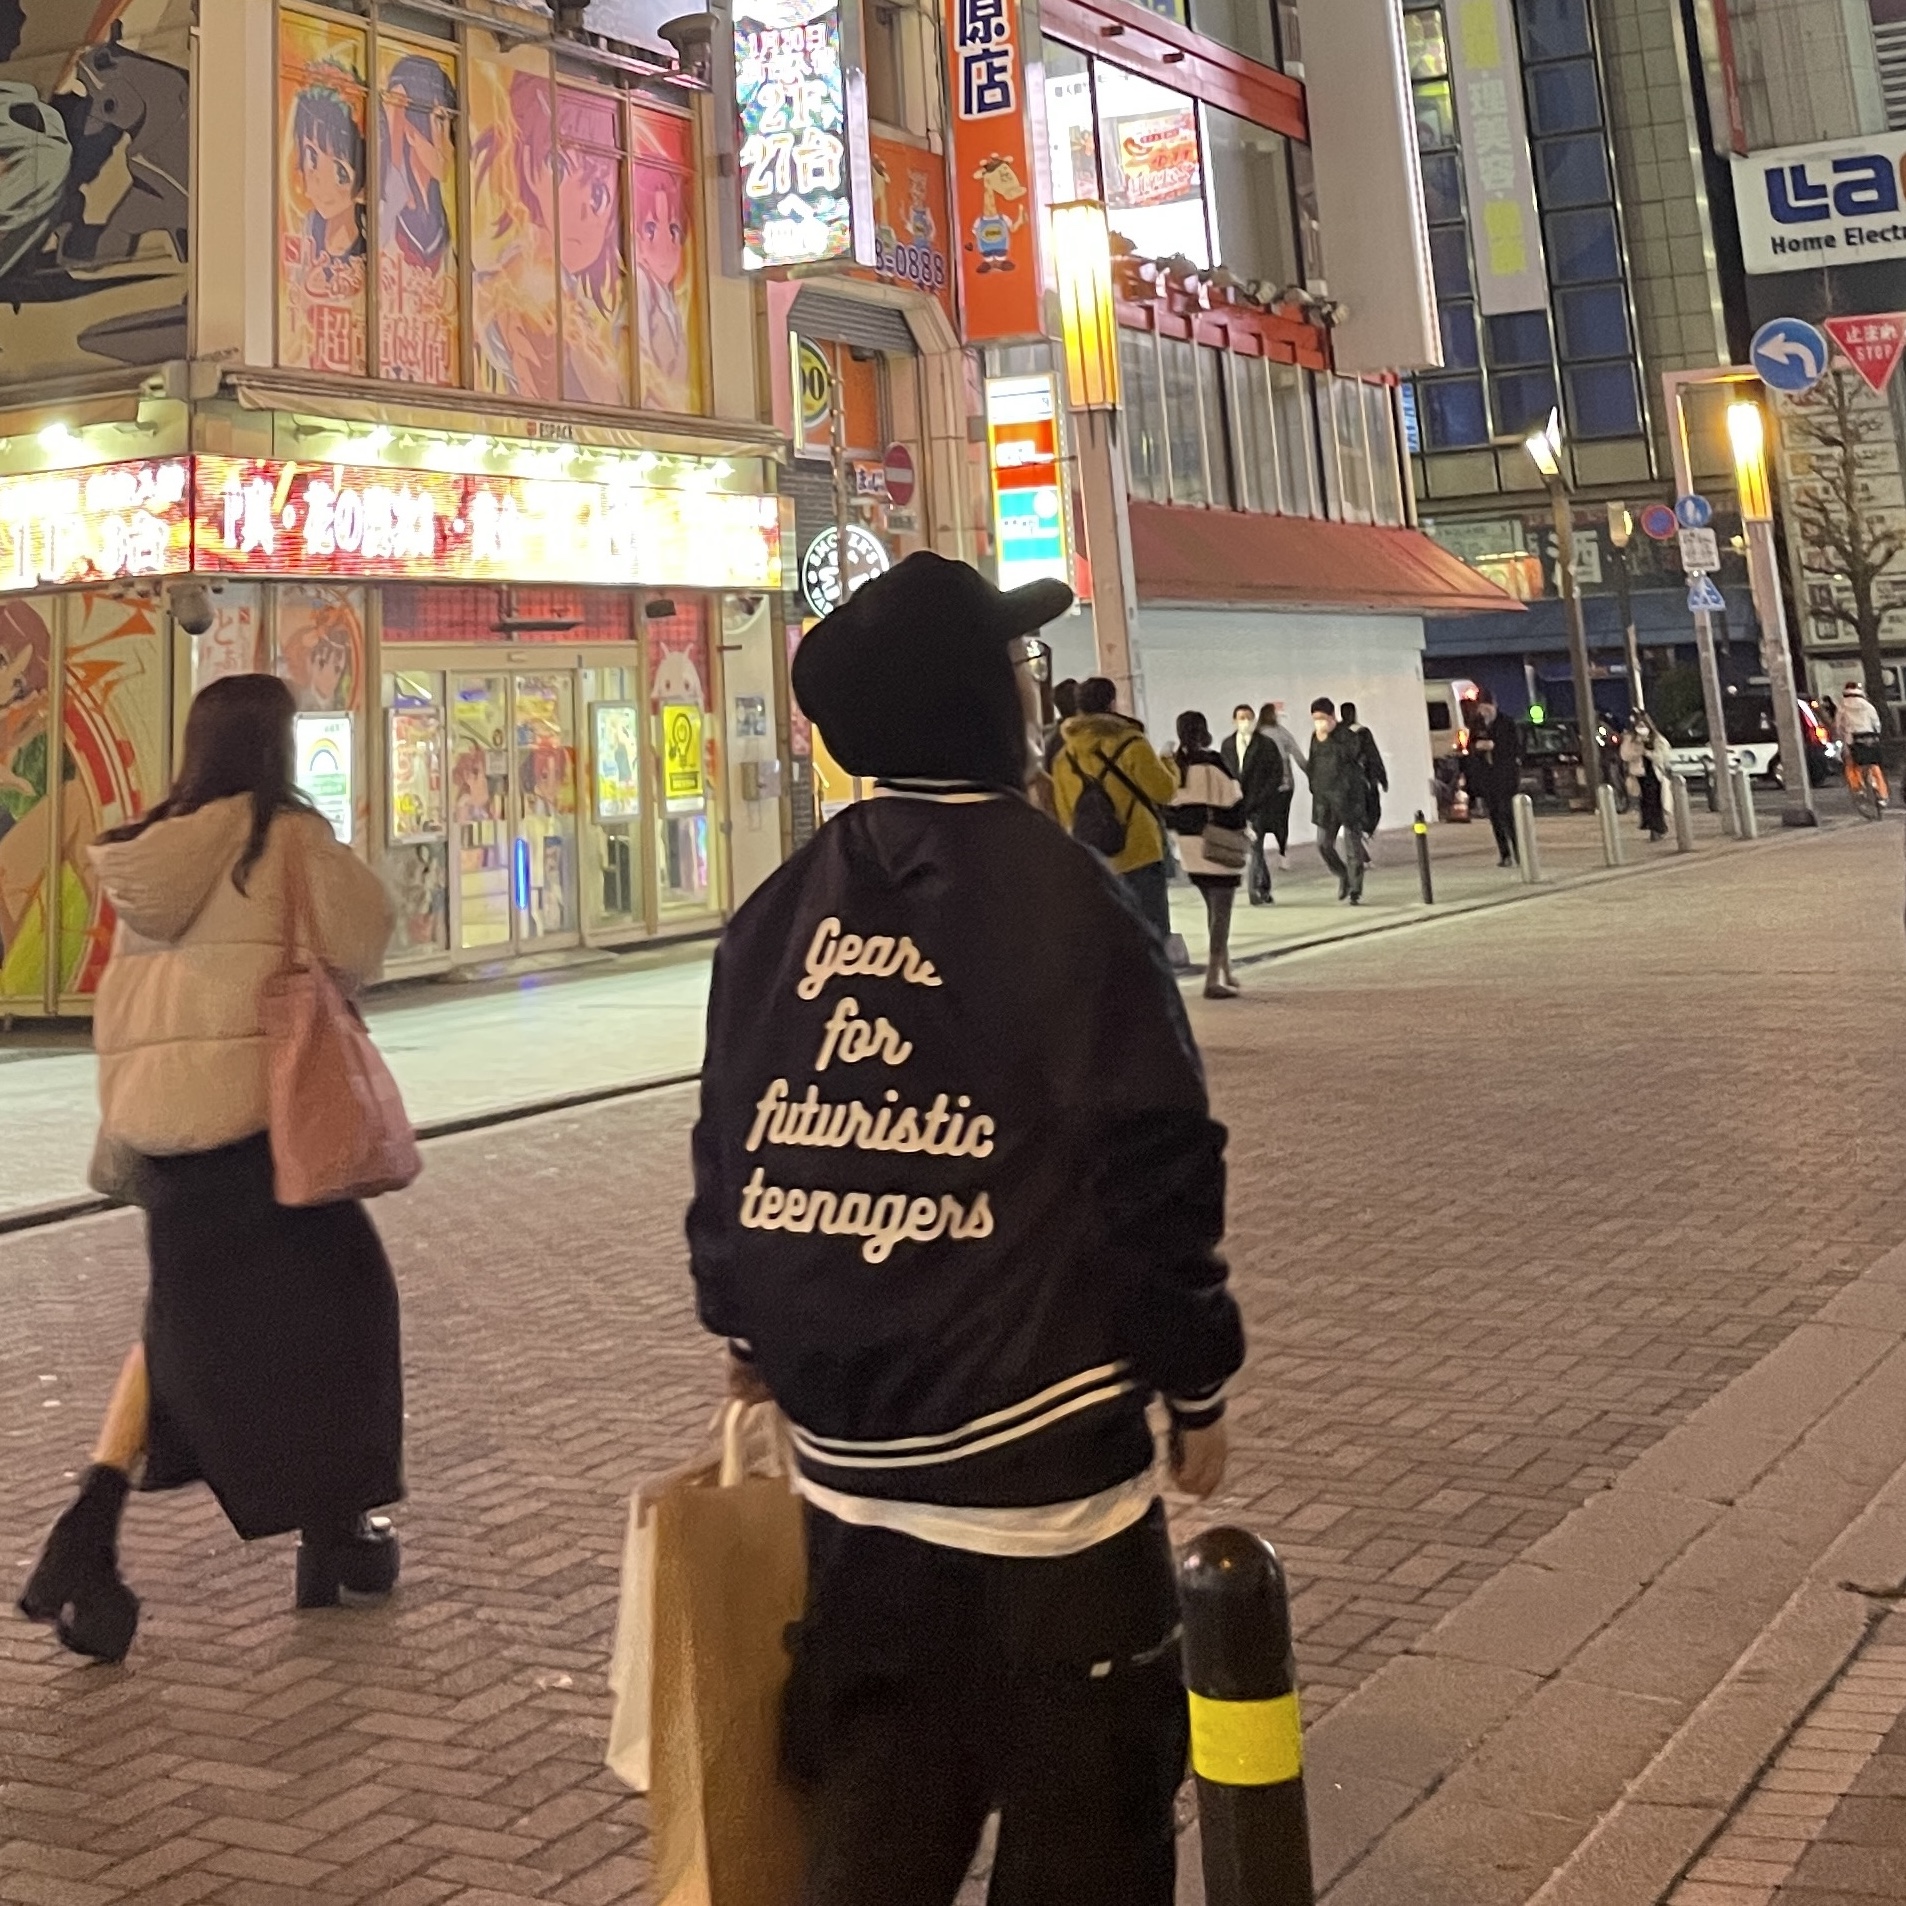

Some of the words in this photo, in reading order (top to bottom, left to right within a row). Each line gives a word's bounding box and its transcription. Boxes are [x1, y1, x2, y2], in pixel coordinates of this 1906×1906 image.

[1771, 234, 1837, 255] Home
[1855, 344, 1894, 361] STOP
[815, 996, 913, 1071] for
[745, 1078, 996, 1158] futuristic
[740, 1167, 995, 1264] teenagers
